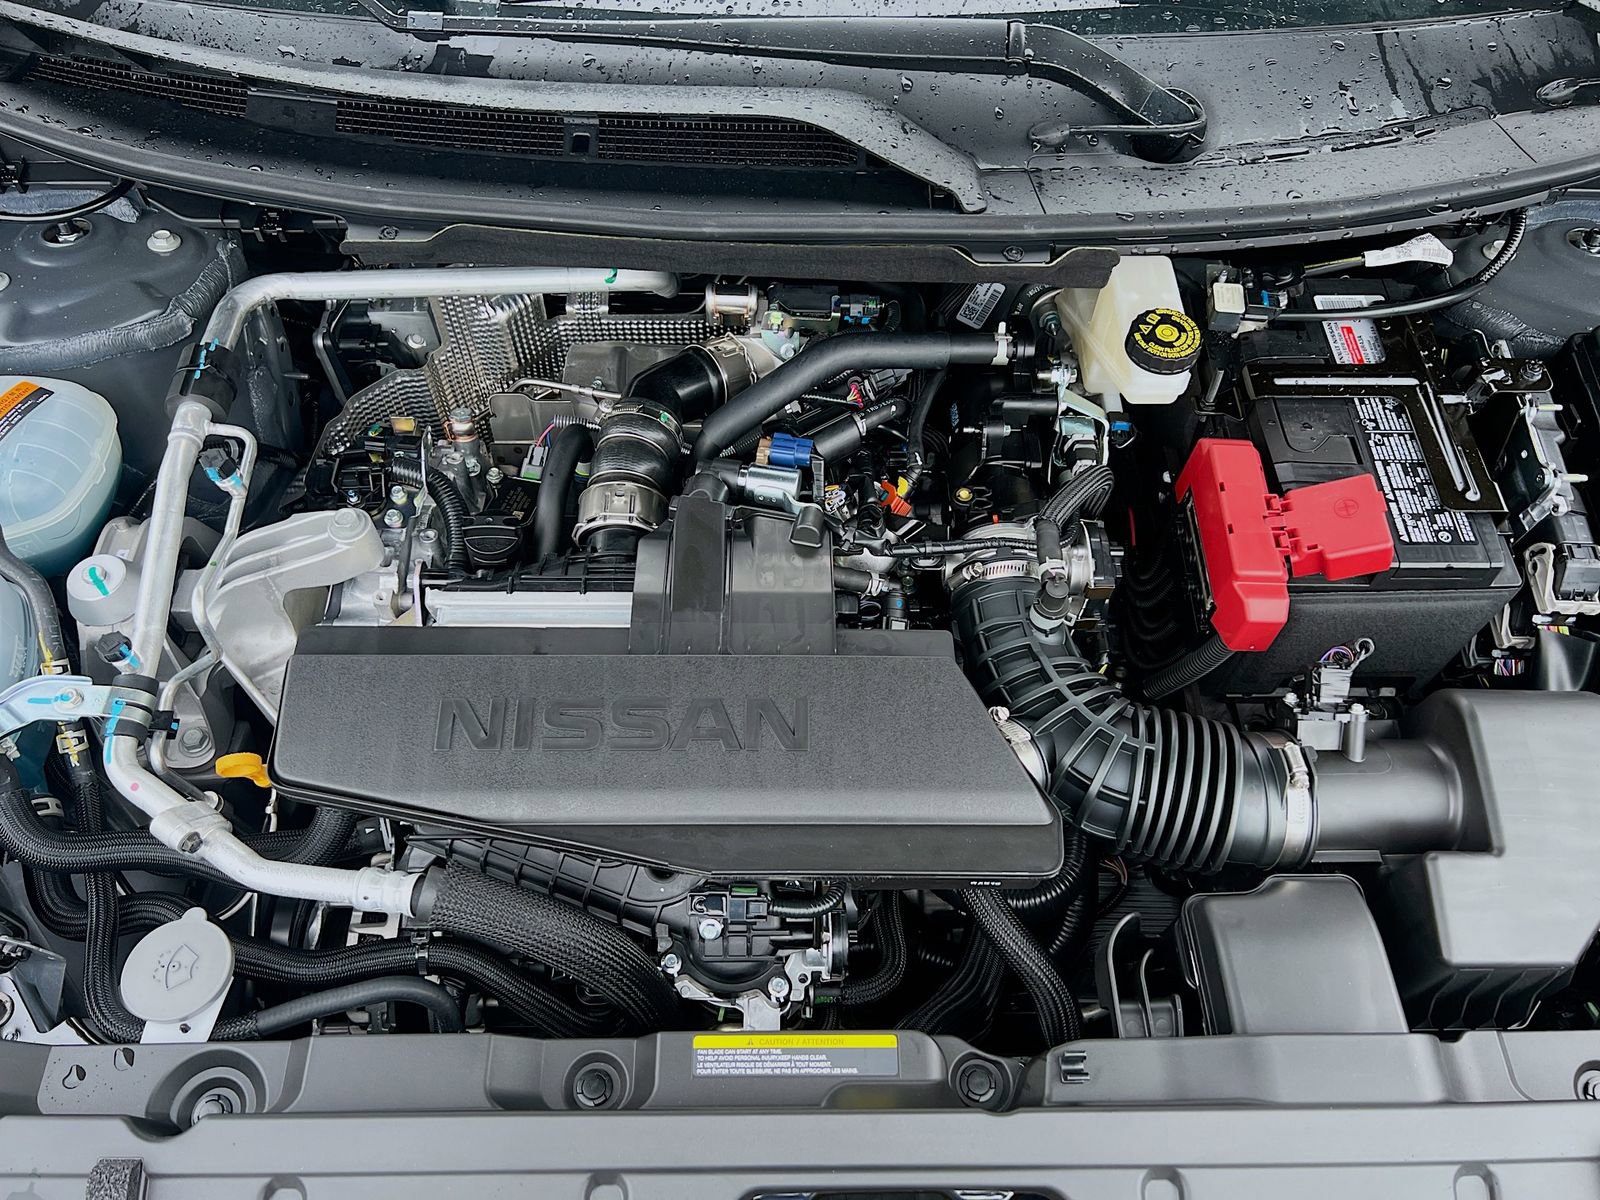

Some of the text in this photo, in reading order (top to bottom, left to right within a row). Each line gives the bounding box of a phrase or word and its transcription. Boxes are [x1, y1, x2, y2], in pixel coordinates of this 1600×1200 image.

[433, 697, 810, 753] NISSAN
[759, 1038, 794, 1046] CAUTION
[802, 1038, 845, 1046] ATTENTION
